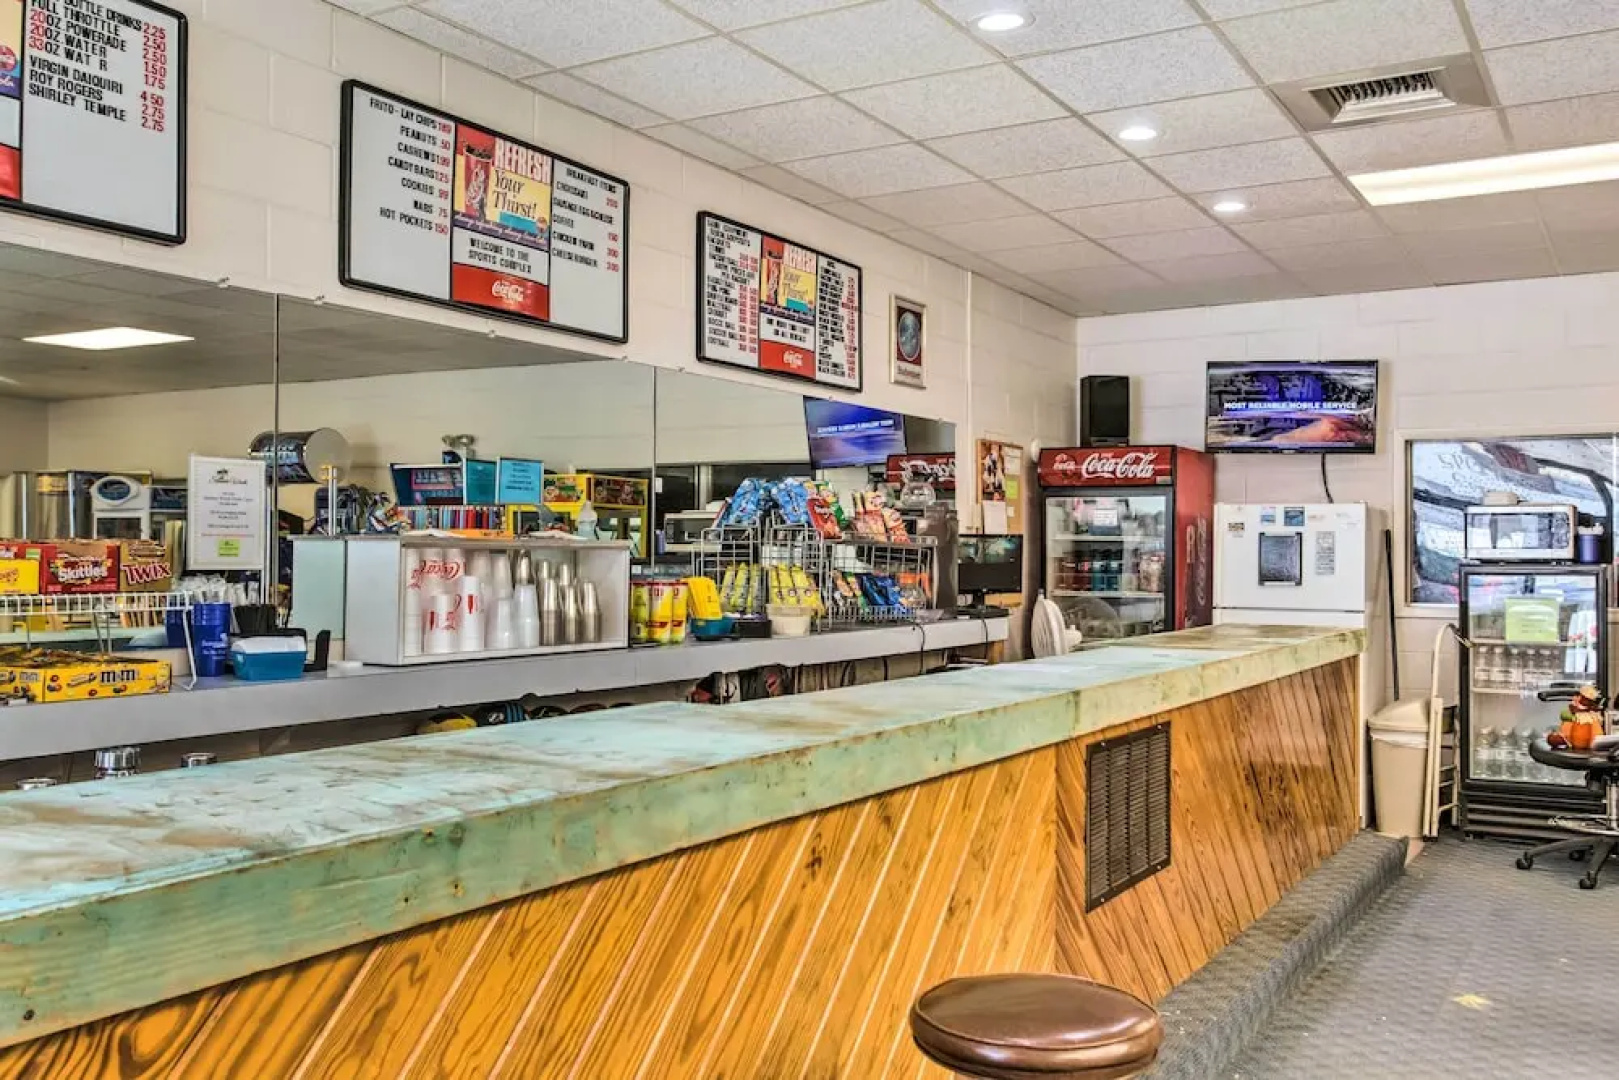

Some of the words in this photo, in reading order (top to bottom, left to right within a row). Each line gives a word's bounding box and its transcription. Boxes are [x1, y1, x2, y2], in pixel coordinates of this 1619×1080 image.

[64, 6, 120, 36] THROTTLE
[107, 8, 142, 31] DRINKS
[65, 34, 107, 58] WATER
[66, 21, 127, 52] POWERADE
[29, 55, 69, 78] VIRGIN
[72, 68, 123, 94] DAIQUIRI
[29, 69, 54, 88] ROY
[57, 77, 103, 101] ROGERS
[28, 82, 76, 108] SHIRLEY
[84, 98, 126, 122] TEMPLE
[400, 125, 437, 147] PEANUTS
[397, 141, 436, 163] CASHEWS
[495, 138, 551, 186] REFRESH
[401, 177, 434, 195] COOKIES
[495, 169, 525, 193] Your
[492, 188, 536, 219] Thirst!
[380, 206, 396, 220] HOT
[400, 212, 433, 231] POCKETS
[468, 250, 497, 264] SPORTS
[500, 258, 532, 274] COMPLEX
[470, 238, 503, 254] WELCOME
[506, 248, 516, 258] TO
[517, 250, 529, 262] THE
[1224, 402, 1246, 410] MOST
[1248, 402, 1287, 410] RELIABLE
[1289, 402, 1320, 410] MOBILE
[1322, 402, 1357, 410] SERVICE
[1081, 452, 1158, 479] Coca-Cola
[58, 564, 108, 582] Skittles
